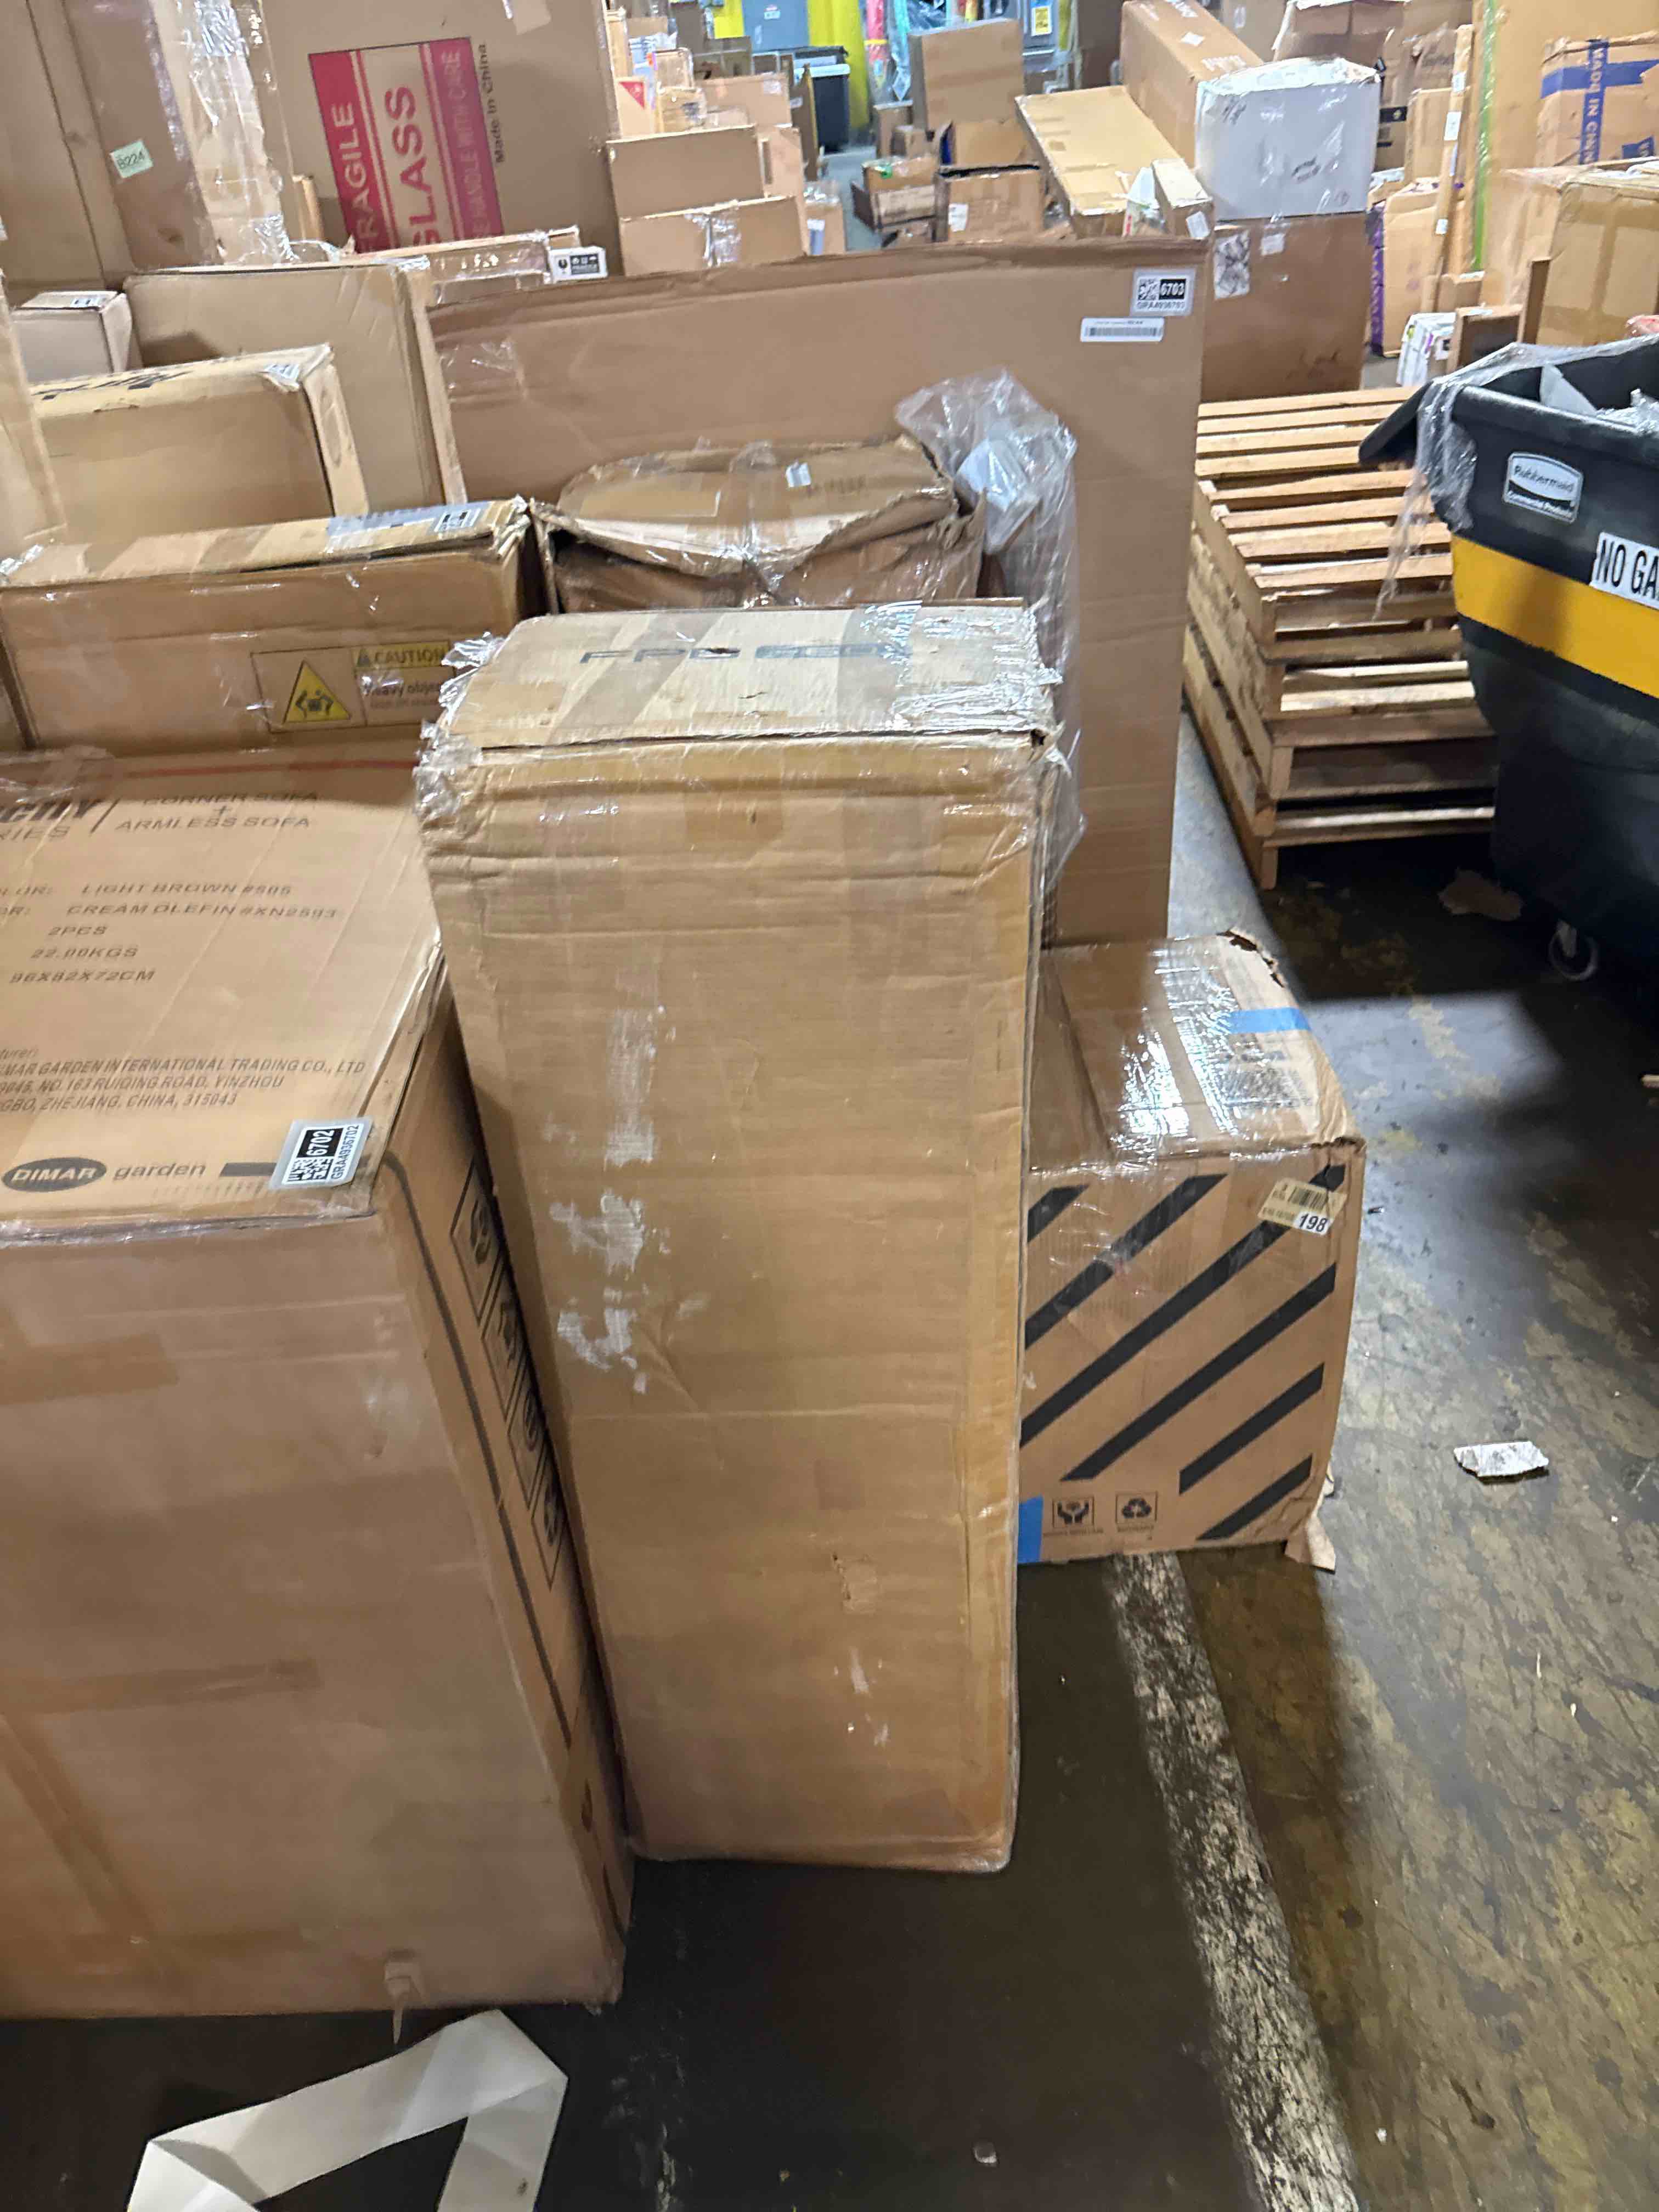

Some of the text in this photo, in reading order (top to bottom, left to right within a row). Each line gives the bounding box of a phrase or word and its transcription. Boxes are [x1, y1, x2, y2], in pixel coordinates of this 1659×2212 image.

[478, 44, 493, 93] China
[490, 119, 505, 163] Made
[1596, 539, 1659, 601] NO GA
[374, 647, 445, 664] CAUTION
[143, 792, 247, 805] CORNER
[115, 816, 310, 831] ARMLESS SOFA
[81, 882, 145, 896] LIGHT
[151, 883, 237, 894] BROWN
[66, 904, 148, 916] CREAM
[153, 902, 236, 915] OLEFIN
[48, 926, 108, 936] 2PCS
[0, 1062, 37, 1076] MAR
[38, 1060, 103, 1075] GARDEN
[103, 1057, 224, 1071] INTERNATIONAL
[230, 1058, 300, 1071] TRADING
[336, 1060, 366, 1074] LTD
[215, 1074, 285, 1089] YINZHOU
[126, 1093, 178, 1110] CHINA,
[306, 1130, 334, 1156] 6702
[11, 1163, 206, 1182] DIMAR garden
[1300, 1213, 1328, 1232] 198
